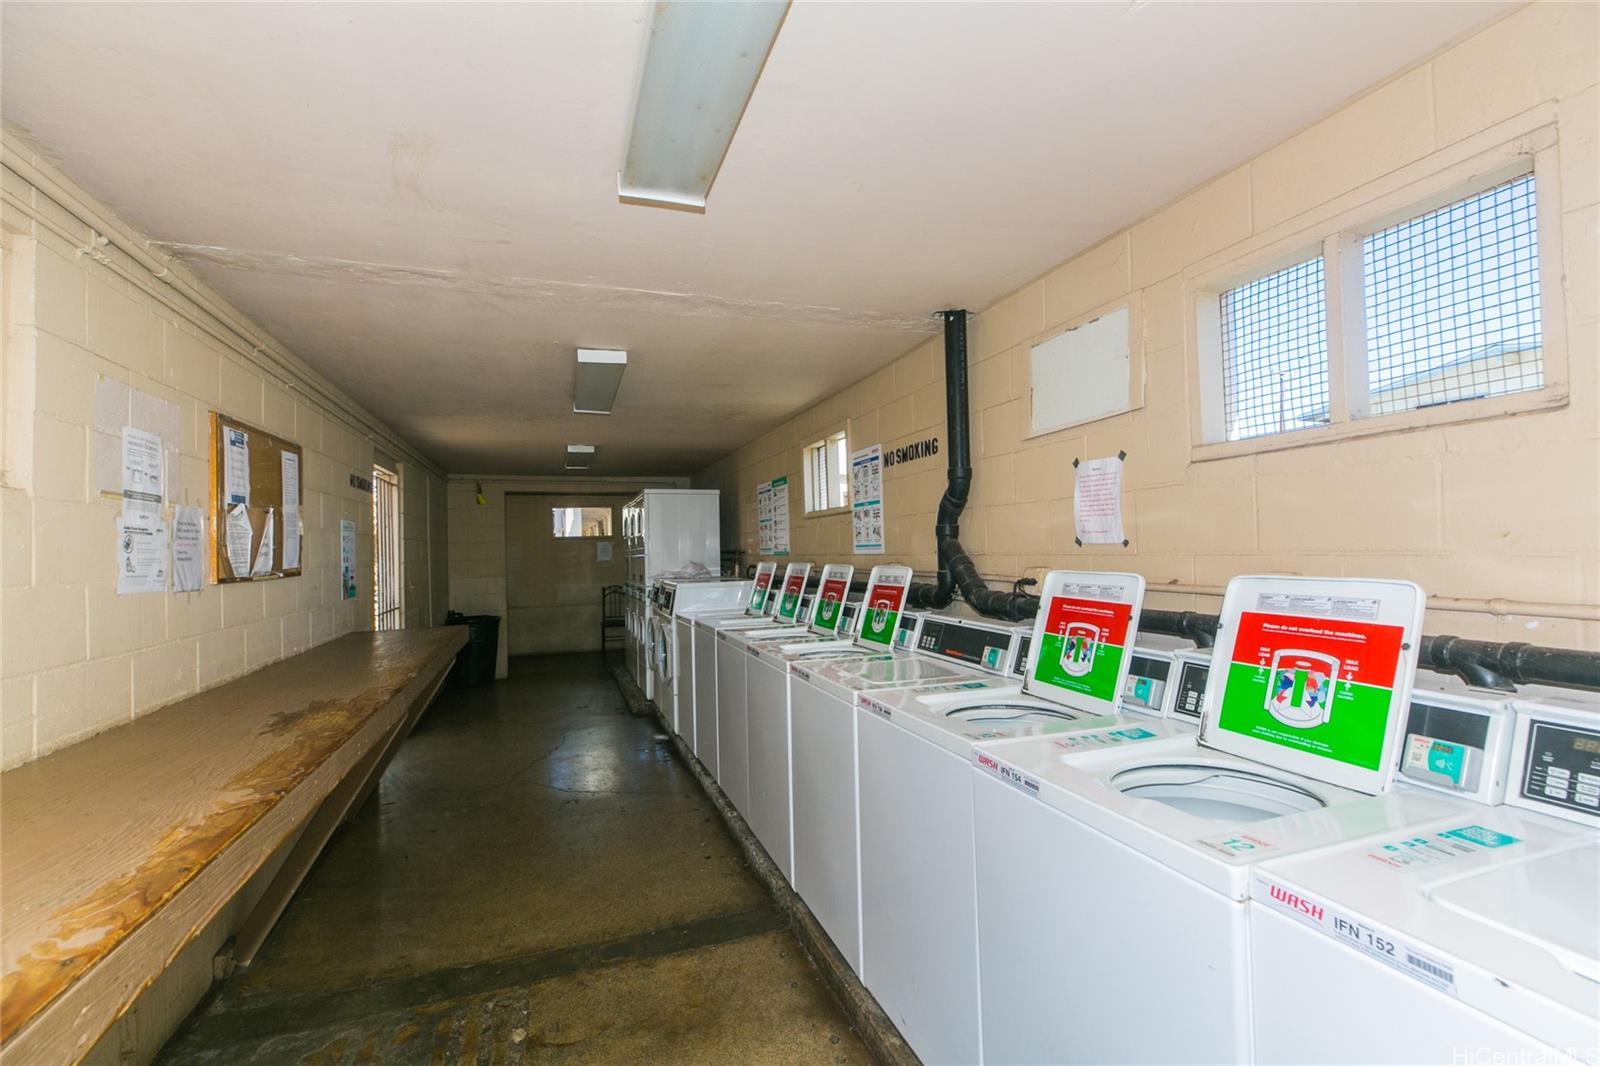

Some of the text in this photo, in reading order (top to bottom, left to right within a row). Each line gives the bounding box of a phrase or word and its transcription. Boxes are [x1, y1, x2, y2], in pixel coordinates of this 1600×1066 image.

[883, 438, 938, 468] NO SMOKING
[1262, 622, 1280, 630] Please
[1343, 664, 1360, 672] LOAD
[1345, 658, 1359, 666] MAX
[978, 754, 998, 770] WASH
[1000, 766, 1011, 778] IFN
[1270, 884, 1396, 957] WASH IFN 152
